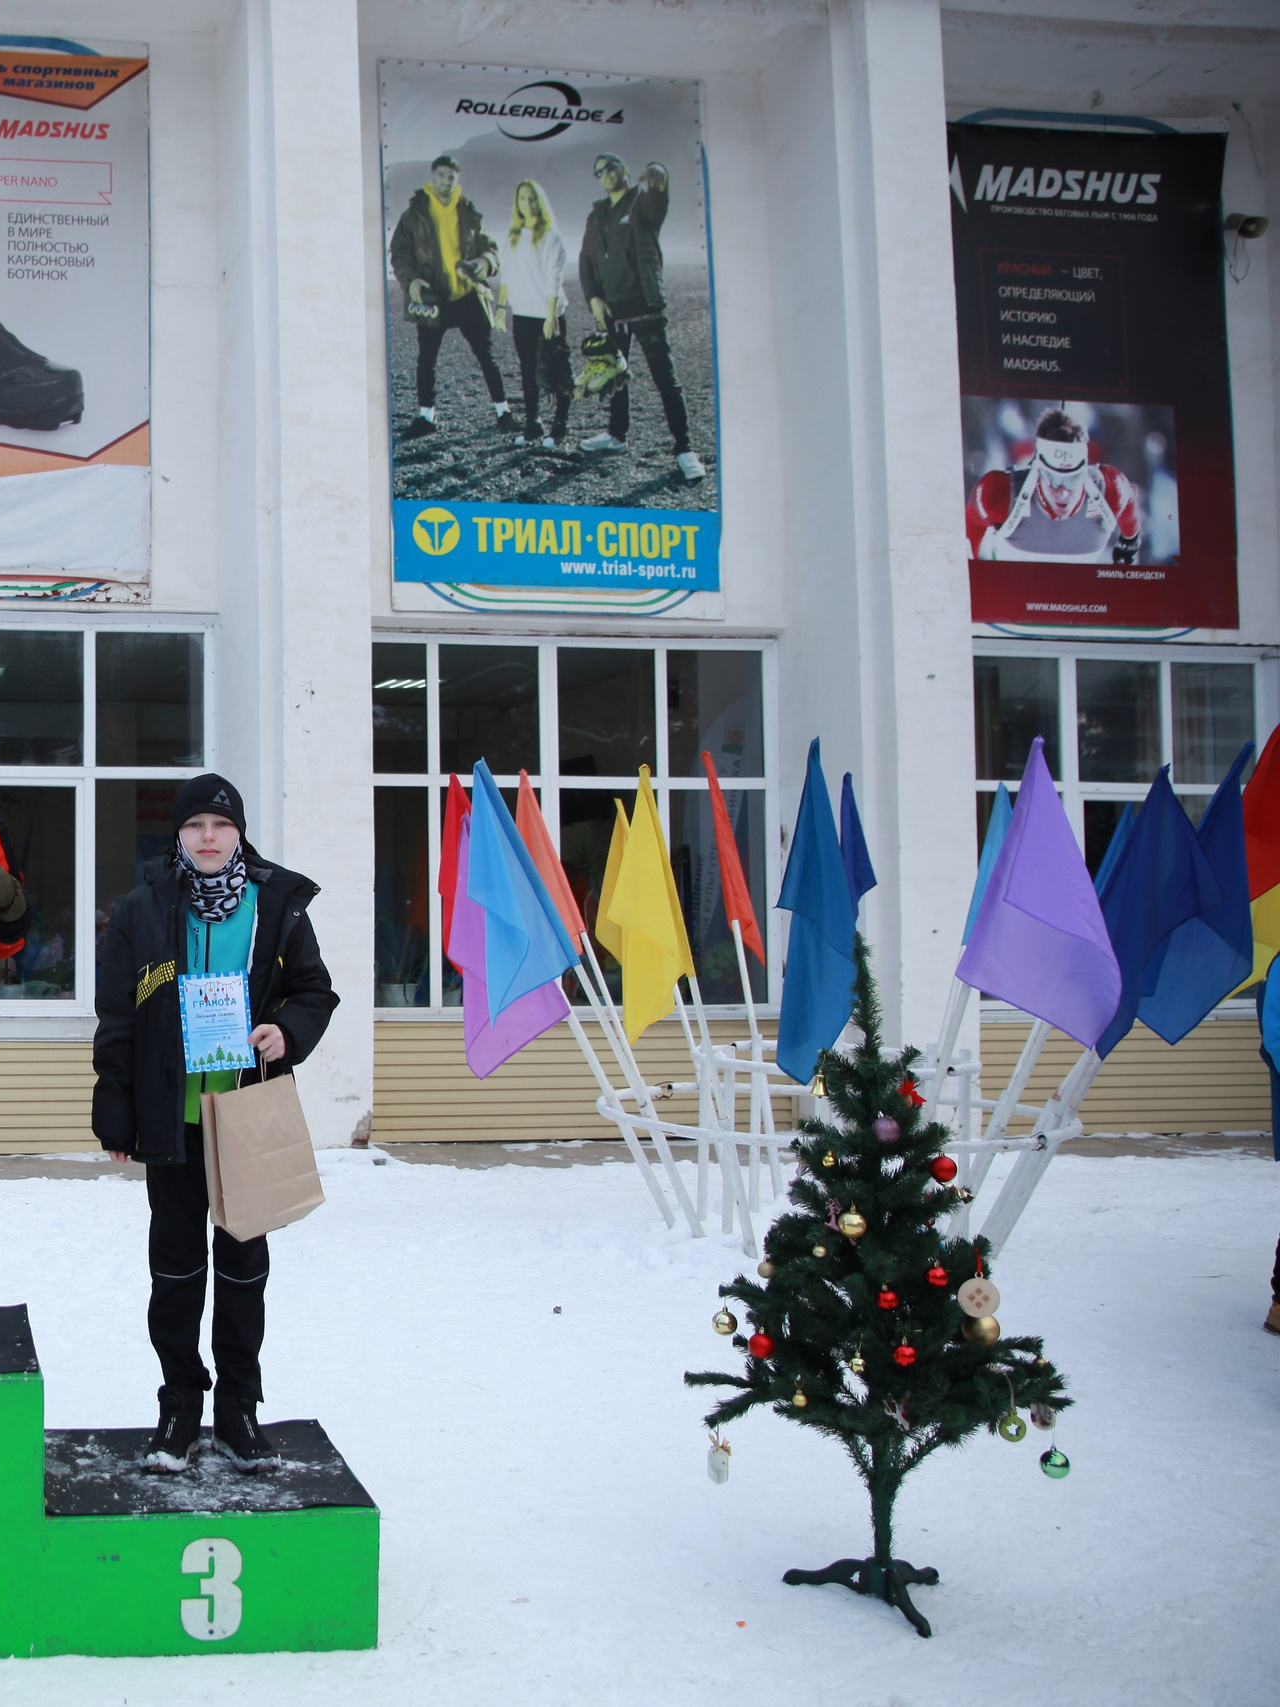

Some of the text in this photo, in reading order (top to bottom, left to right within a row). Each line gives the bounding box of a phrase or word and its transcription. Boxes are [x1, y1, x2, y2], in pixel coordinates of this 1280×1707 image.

[12, 64, 120, 78] спортивных
[3, 77, 95, 91] магазинов
[455, 98, 605, 123] ROLLERBLADE
[21, 176, 58, 188] NANO
[973, 164, 1162, 205] MADSHUS
[8, 212, 110, 227] ЕДИНСТВЕННЫЙ
[990, 204, 1053, 217] ПРОИЗВОДСТВО
[1054, 208, 1090, 218] БЕГОВЫХ
[1091, 210, 1110, 219] ЛЫЖ
[1119, 212, 1137, 221] 1906
[1137, 213, 1158, 222] ГОДА
[8, 227, 53, 239] В МИРЕ
[8, 240, 89, 254] ПОЛНОСТЬЮ
[8, 254, 95, 268] КАРБОНОВЫЙ
[8, 269, 68, 281] БОТИНОК
[997, 261, 1053, 276] КРАСНЫЙ
[1072, 267, 1103, 280] ЦВЕТ,
[998, 285, 1096, 304] ОПРЕДЕЛЯЮЩИЙ
[1000, 309, 1057, 324] ИСТОРИЮ
[1002, 333, 1072, 349] И НАСЛЕДИЕ
[1003, 357, 1062, 372] MADSHUS.
[561, 560, 697, 579] www.trial-sport.ru
[1096, 569, 1166, 580] ЭМИЛЬ СВЕНДСЕН
[1026, 602, 1108, 614] WWW.MADSHUS.COM
[180, 1536, 242, 1641] 3
